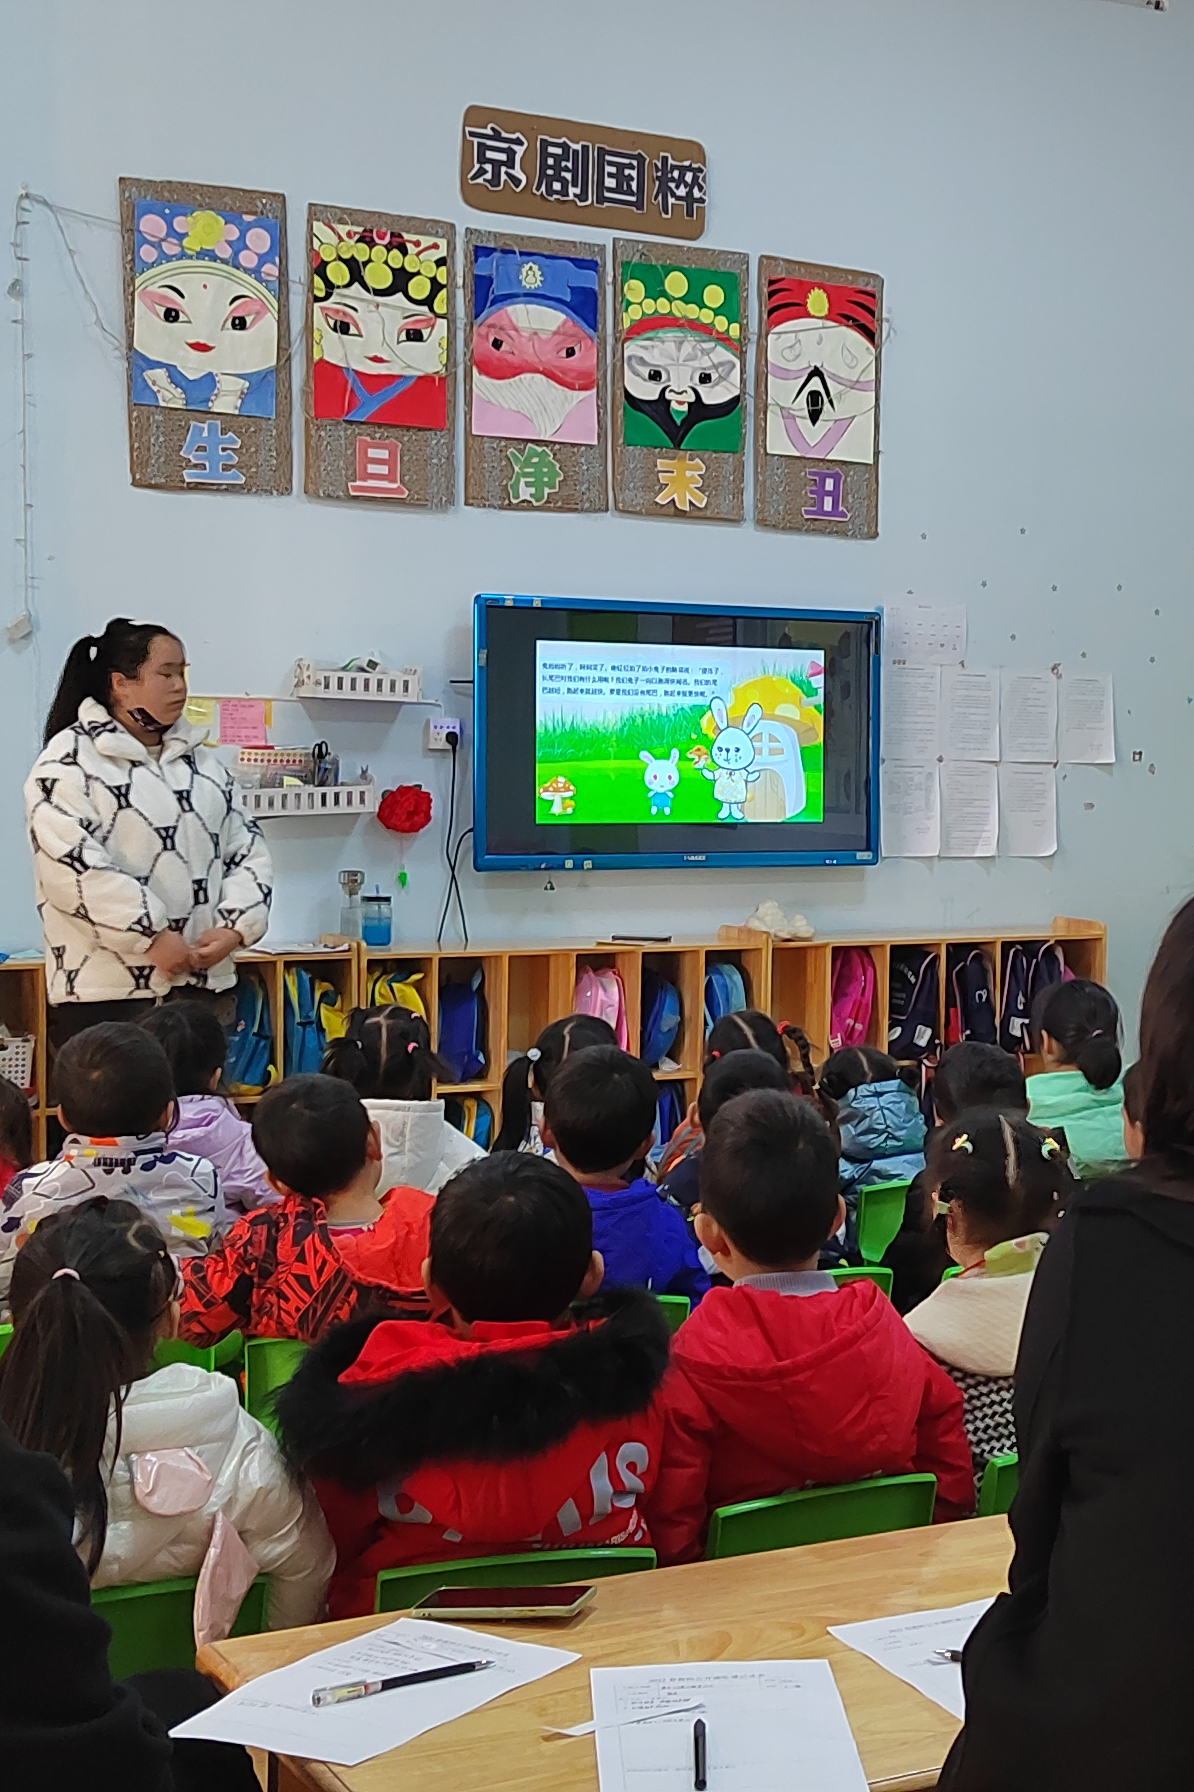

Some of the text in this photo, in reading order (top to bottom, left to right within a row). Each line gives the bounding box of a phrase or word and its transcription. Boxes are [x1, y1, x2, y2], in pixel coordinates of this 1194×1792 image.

[466, 123, 707, 220] 京剧国粹
[182, 421, 246, 487] 生
[348, 436, 409, 498] 旦
[507, 445, 563, 506] 净
[655, 453, 709, 512] 末
[801, 468, 849, 522] 丑
